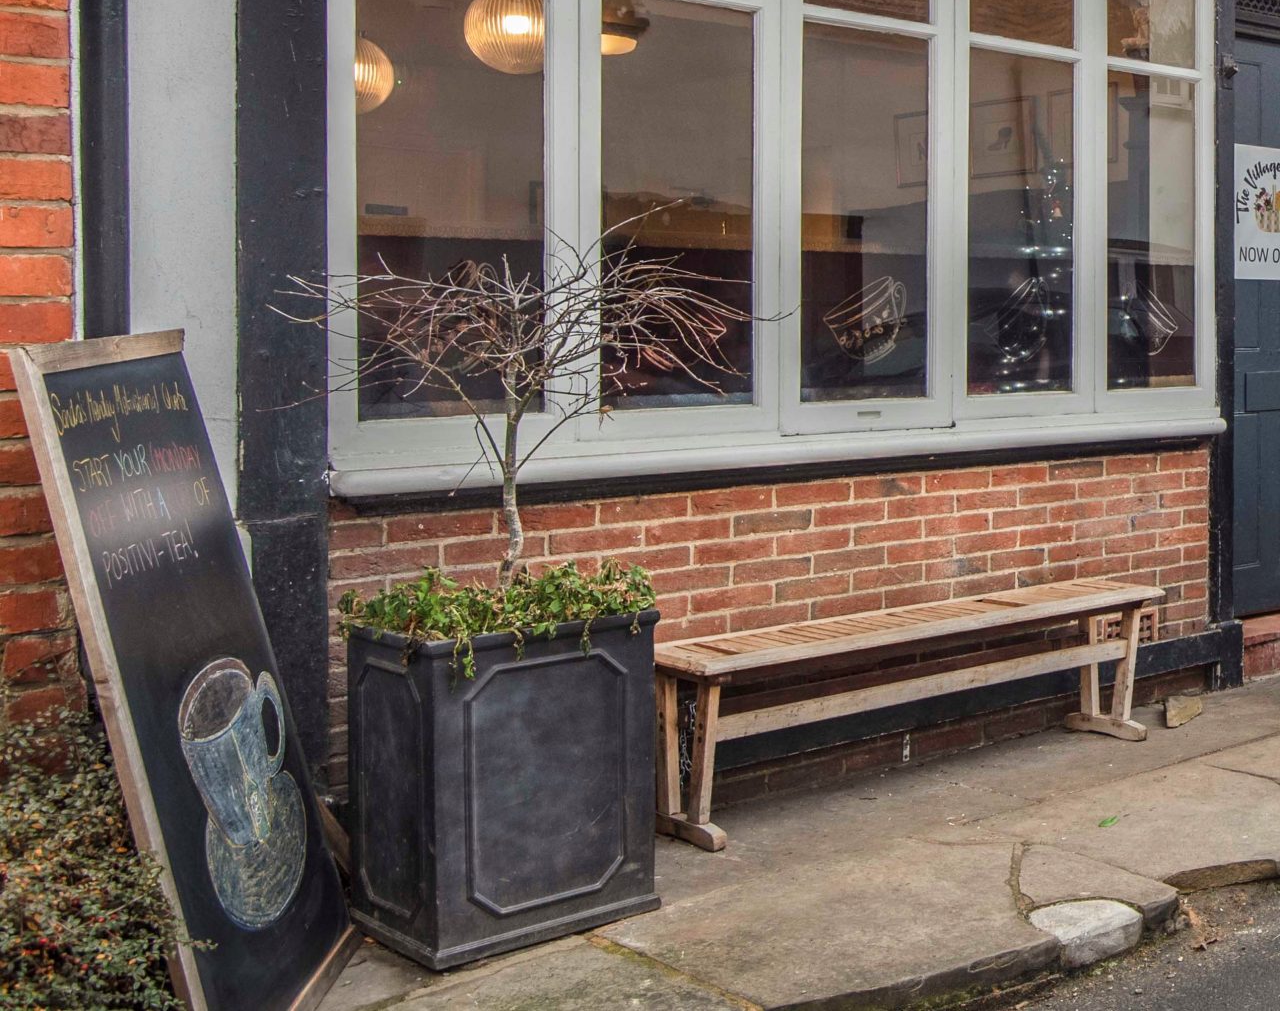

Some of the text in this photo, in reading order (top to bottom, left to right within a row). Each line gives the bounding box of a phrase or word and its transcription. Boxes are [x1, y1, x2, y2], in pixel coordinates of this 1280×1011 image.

[1236, 189, 1250, 224] The
[1239, 246, 1269, 263] NOW
[73, 454, 113, 492] START
[113, 444, 152, 482] YOUR
[120, 488, 158, 522] WITH
[156, 486, 171, 521] A
[193, 476, 210, 507] OF
